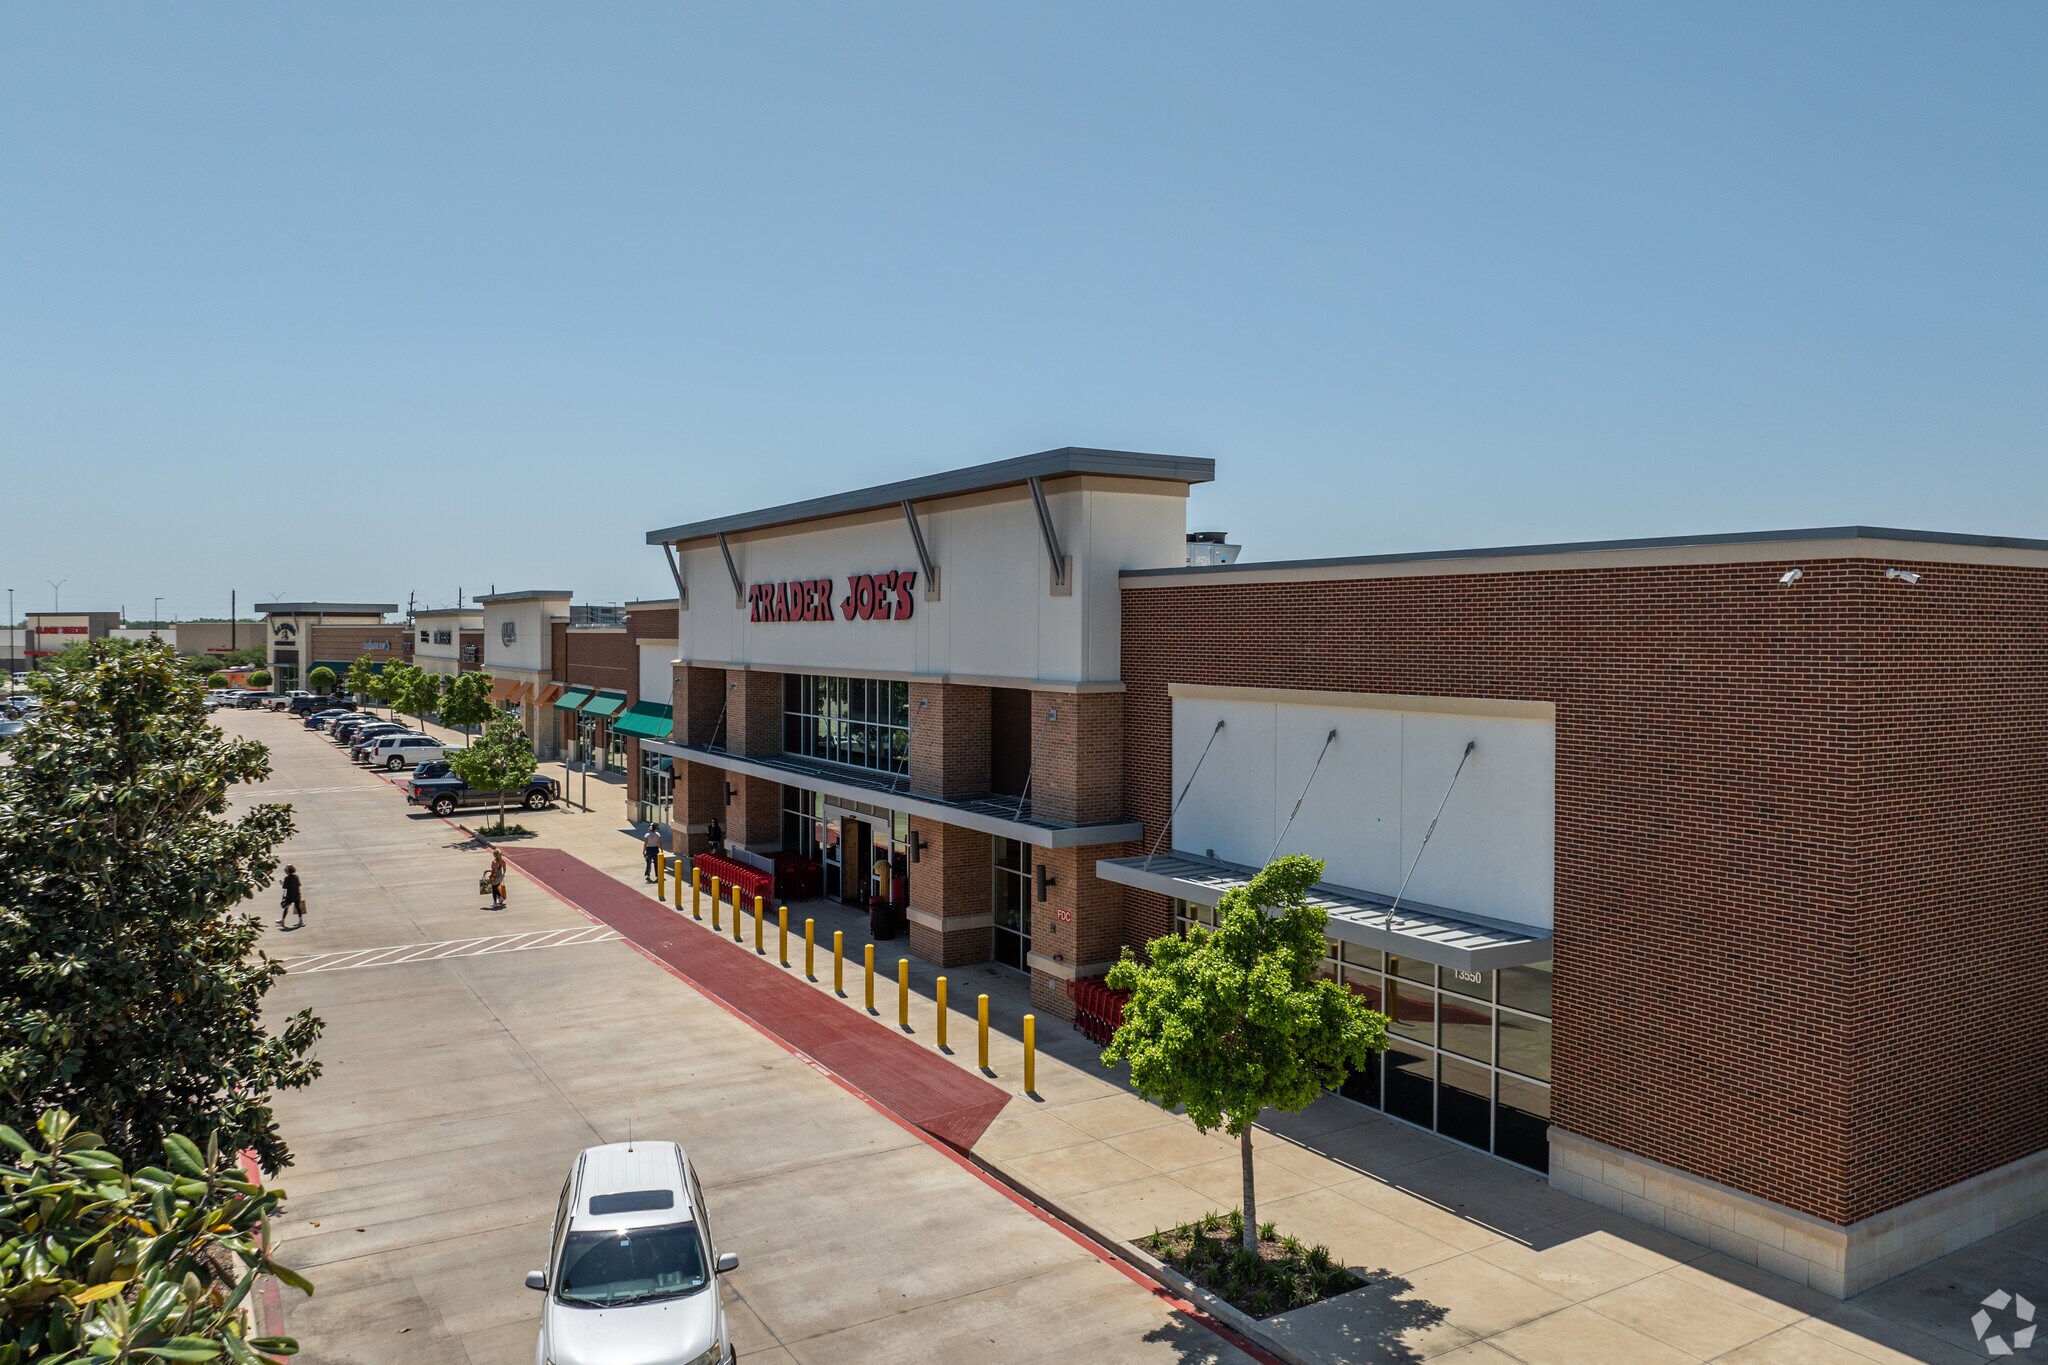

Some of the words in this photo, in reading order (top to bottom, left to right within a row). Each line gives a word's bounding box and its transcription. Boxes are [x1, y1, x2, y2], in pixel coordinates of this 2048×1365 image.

[748, 578, 834, 622] TRADER
[840, 569, 917, 621] JOE'S
[1057, 909, 1070, 921] FDC
[1454, 969, 1481, 983] 13550
